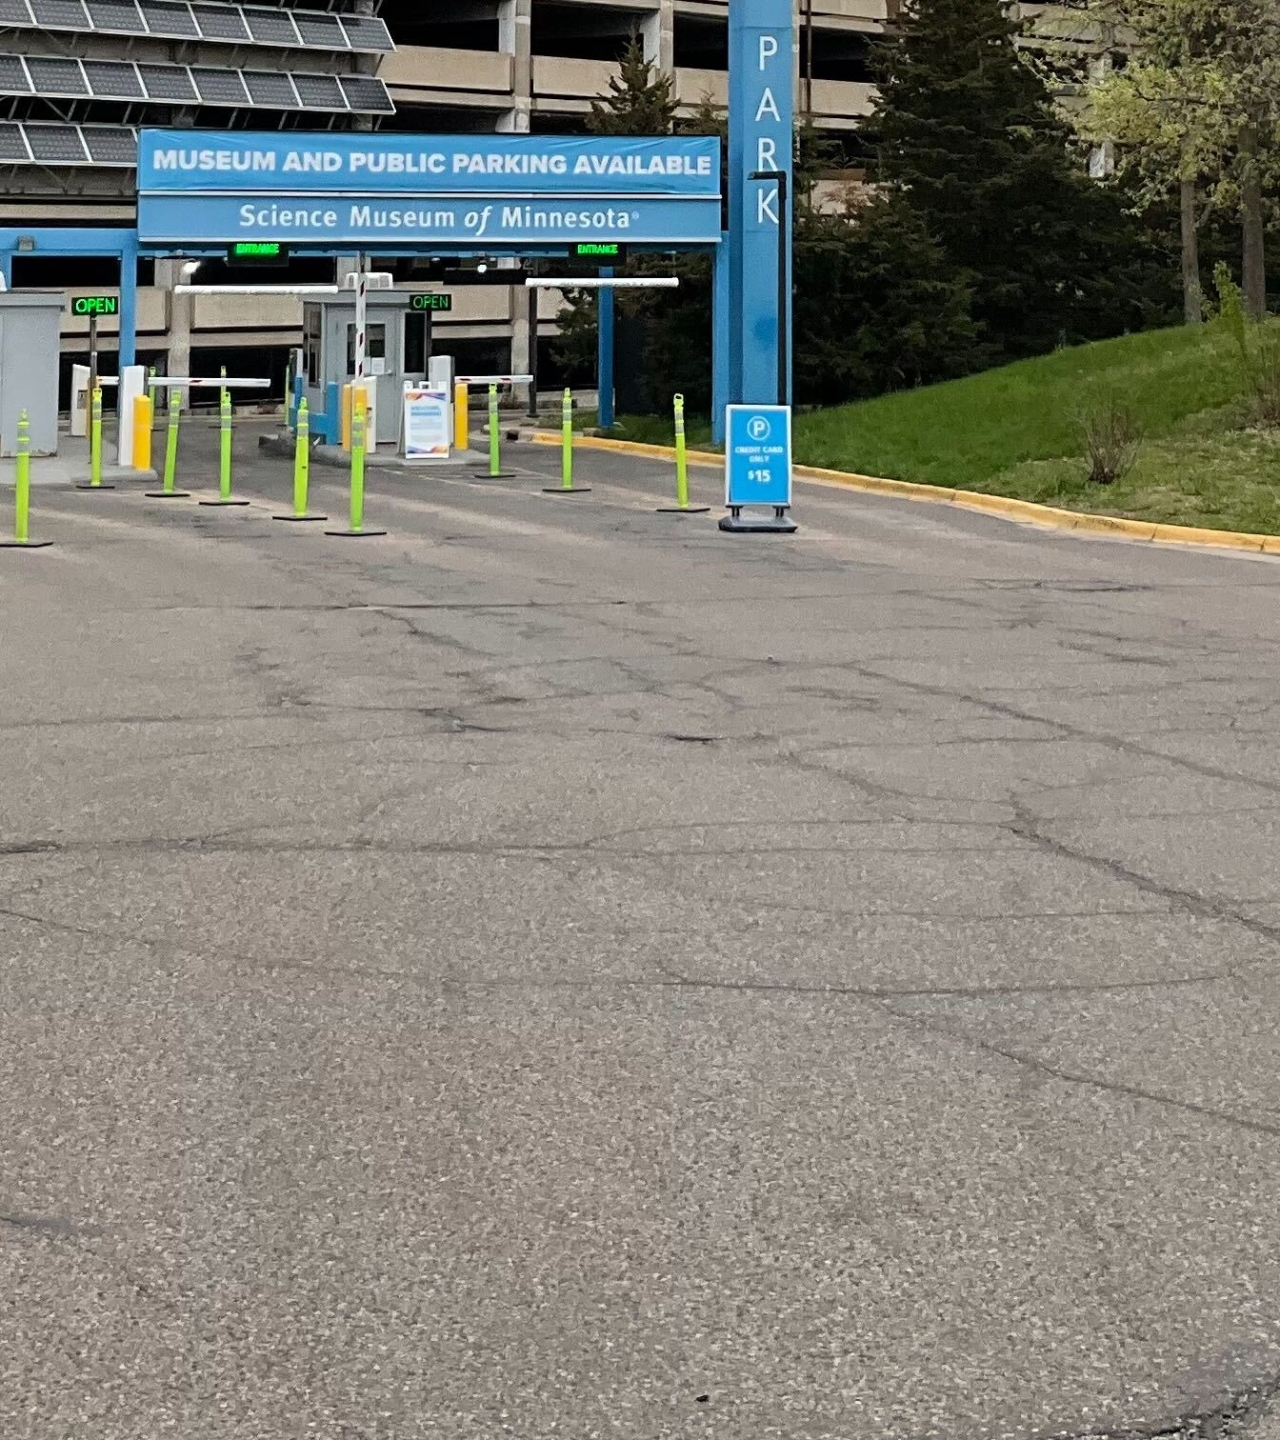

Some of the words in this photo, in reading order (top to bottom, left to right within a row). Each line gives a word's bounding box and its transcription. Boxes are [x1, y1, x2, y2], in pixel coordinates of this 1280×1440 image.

[754, 35, 781, 224] PARK
[153, 150, 276, 171] MUSEUM
[282, 152, 343, 172] AND
[350, 153, 446, 173] PUBLIC
[453, 154, 567, 174] PARKING
[574, 155, 711, 175] AVAILABLE
[240, 204, 338, 227] Science
[350, 205, 454, 227] Museum
[464, 206, 493, 236] of
[577, 244, 618, 254] ENTRANCE
[75, 297, 115, 313] OPEN
[413, 295, 449, 309] OPEN
[748, 469, 771, 482] $15
